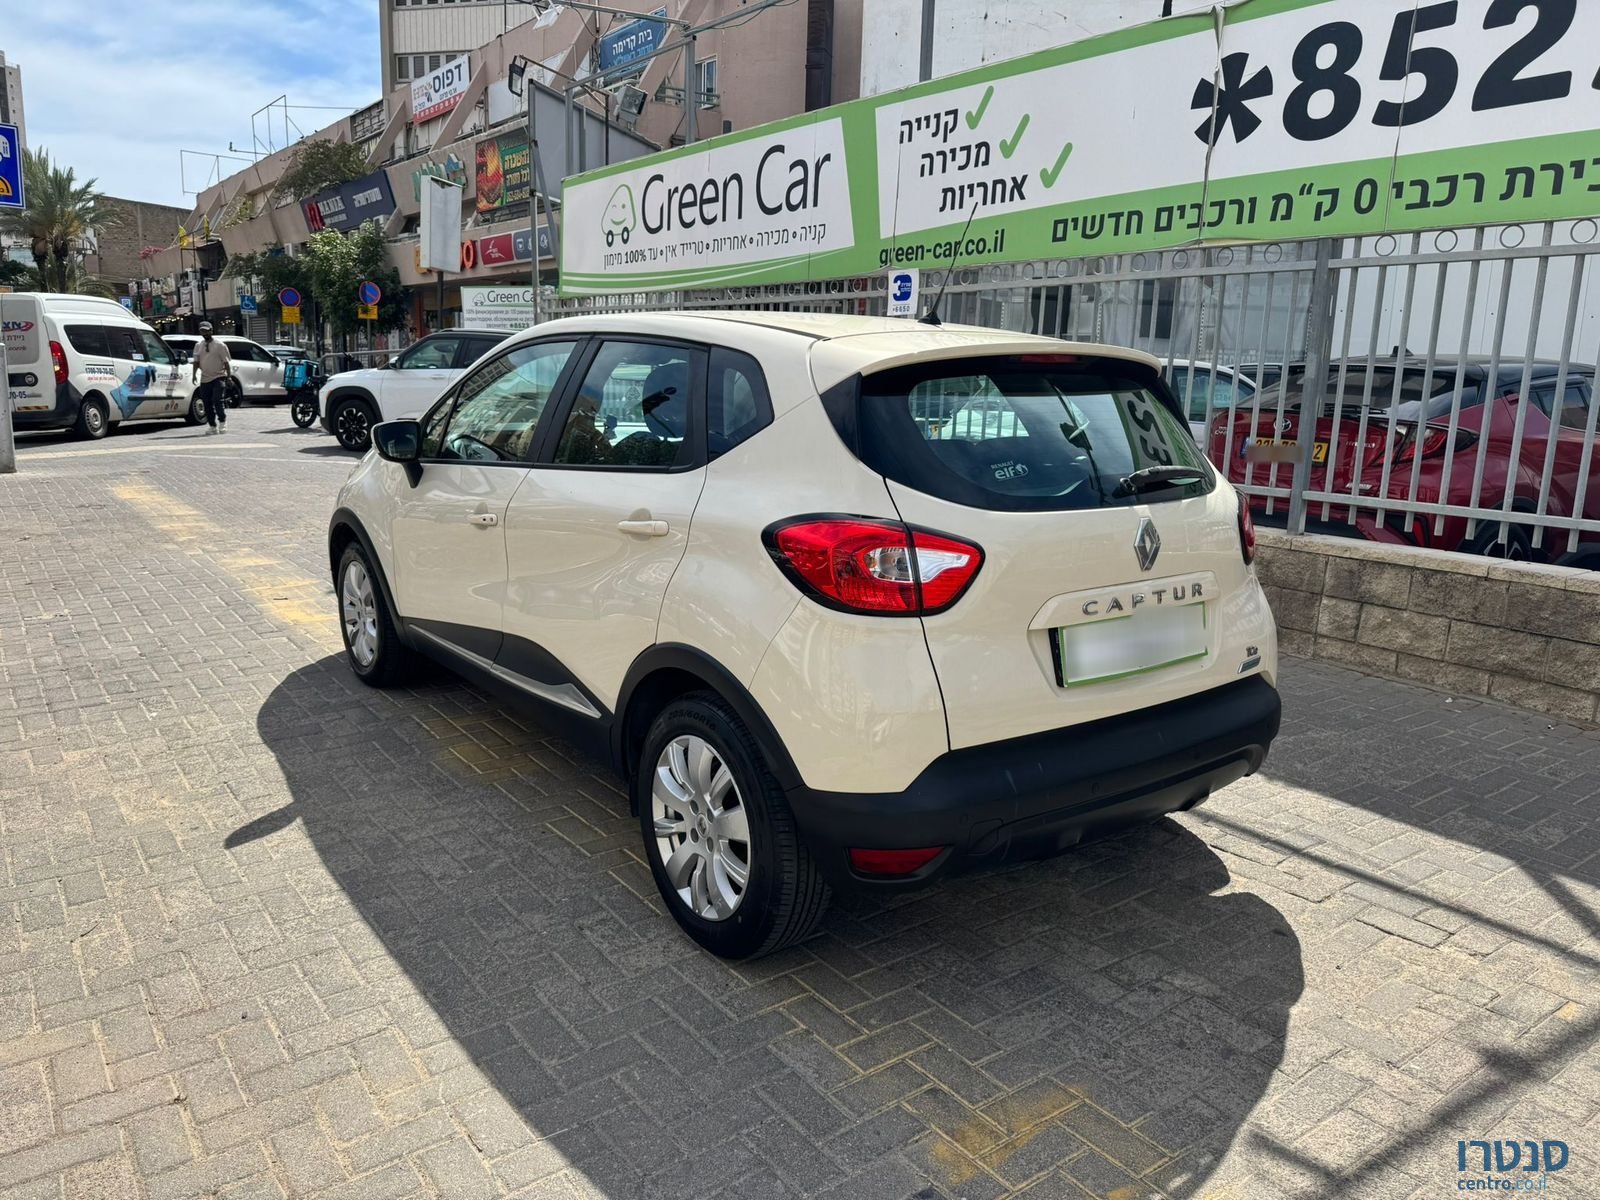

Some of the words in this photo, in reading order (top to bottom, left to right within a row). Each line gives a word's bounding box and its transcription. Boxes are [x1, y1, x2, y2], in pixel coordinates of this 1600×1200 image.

[612, 35, 636, 56] קדימה
[432, 64, 462, 93] דפוס
[1191, 0, 1600, 146] 852
[900, 109, 959, 144] קנייה
[920, 141, 990, 177] מכירה
[641, 172, 743, 235] Green
[755, 144, 831, 216] Car
[939, 175, 1028, 213] אחריות
[1354, 178, 1378, 215] 0
[1392, 172, 1485, 211] רכבי
[1052, 209, 1143, 243] חדשים
[1154, 196, 1256, 233] ורכבים
[680, 240, 703, 255] טרייד
[712, 234, 747, 253] אחריות
[756, 228, 789, 246] מכירה
[800, 223, 826, 245] קניה
[879, 228, 1005, 268] green-car.co.il
[603, 252, 622, 270] מימון
[625, 248, 646, 263] 100%
[648, 247, 658, 262] עד
[665, 244, 677, 262] אין
[487, 290, 520, 302] Green
[522, 290, 535, 302] Ca
[994, 466, 1015, 479] elf
[1082, 582, 1203, 616] CAPTUR
